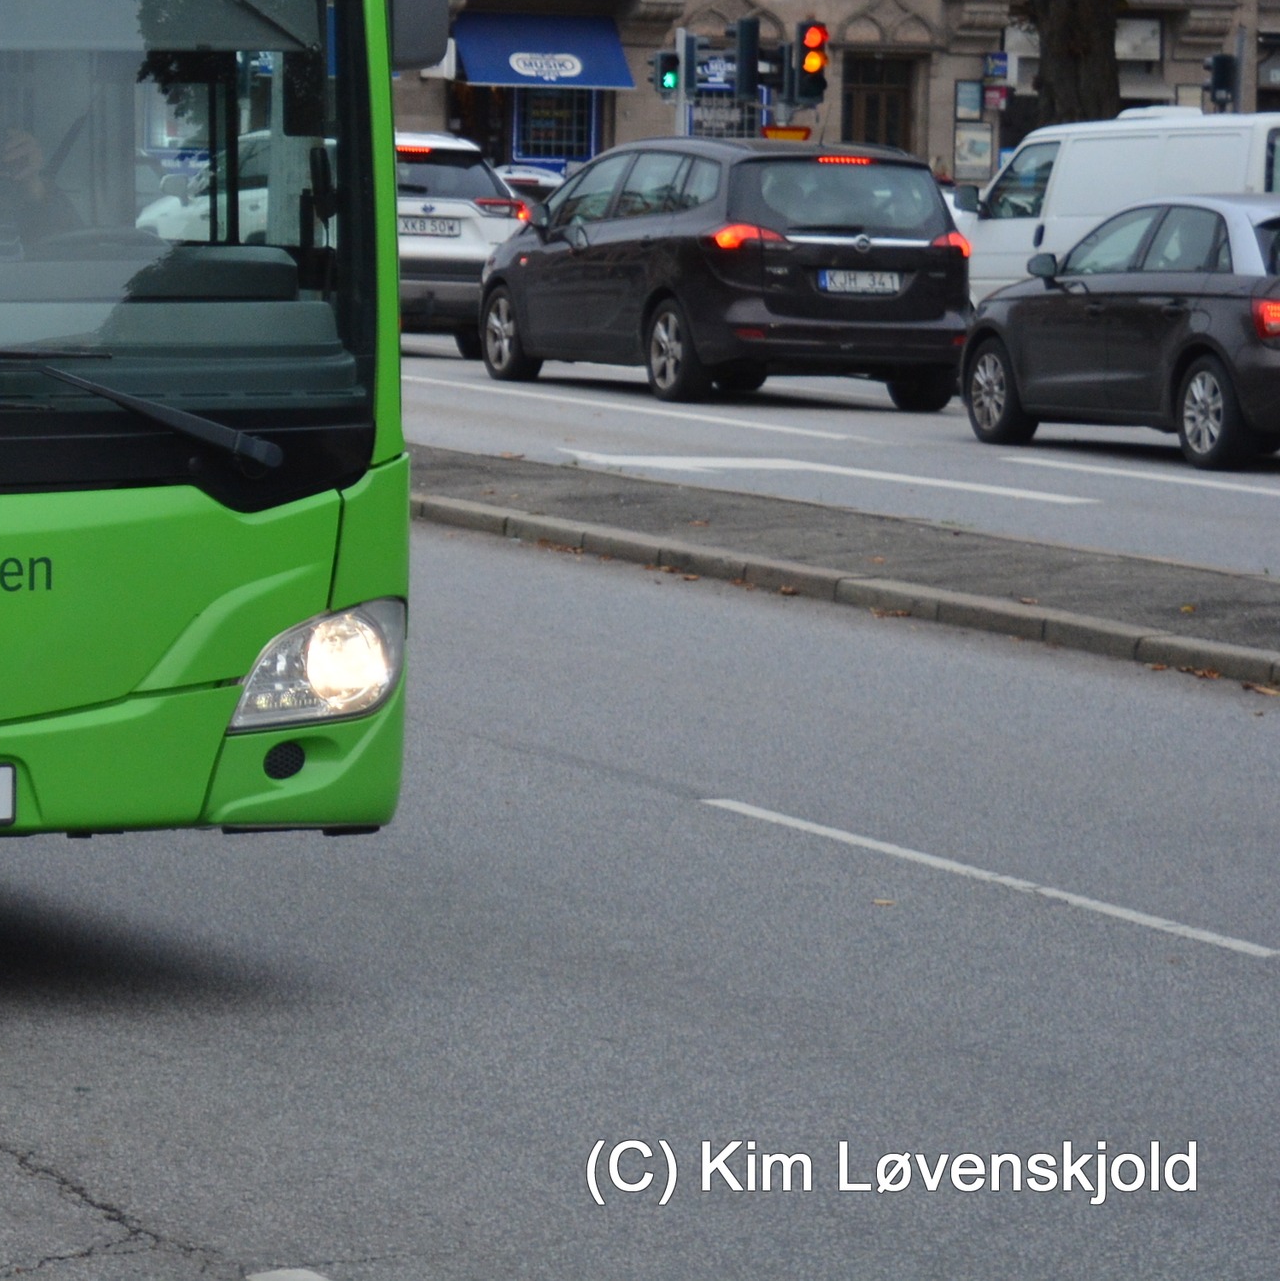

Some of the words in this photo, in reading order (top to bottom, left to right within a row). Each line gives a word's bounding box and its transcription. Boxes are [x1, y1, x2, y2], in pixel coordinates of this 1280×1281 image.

[523, 60, 567, 70] MUSIK
[829, 271, 857, 288] KJH
[869, 271, 895, 289] 341
